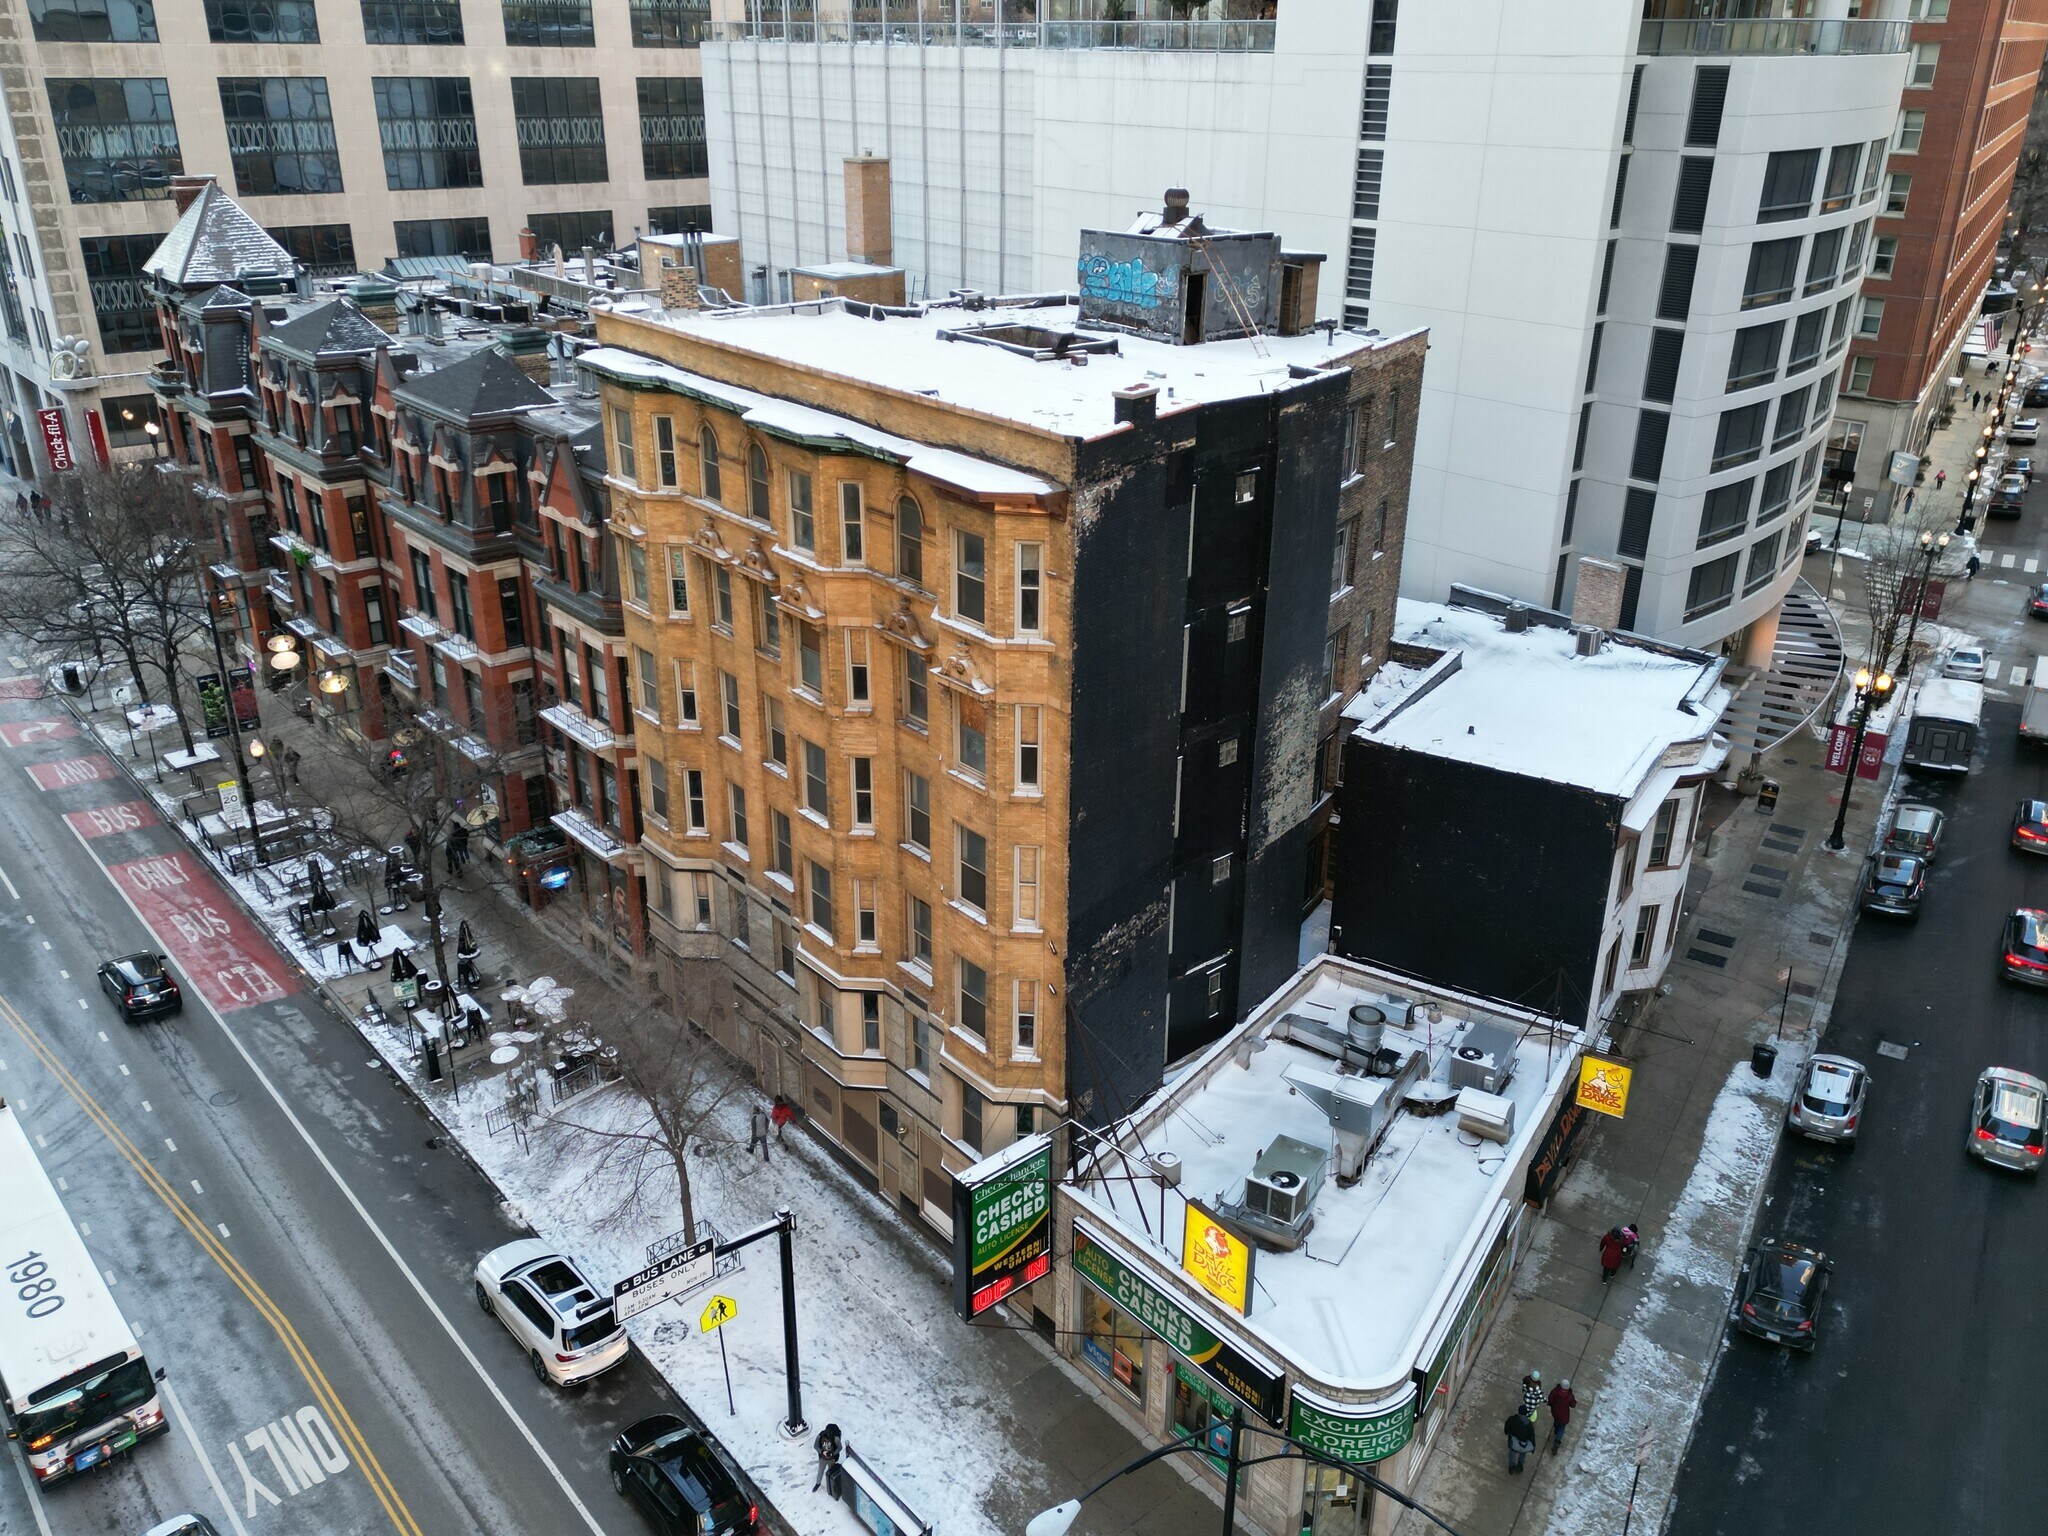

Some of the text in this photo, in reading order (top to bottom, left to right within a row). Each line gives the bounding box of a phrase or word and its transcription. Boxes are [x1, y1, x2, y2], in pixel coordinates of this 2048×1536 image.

[44, 411, 68, 469] Chick-fil-A
[1830, 729, 1846, 766] WELCOME
[54, 758, 99, 784] AND
[223, 794, 238, 805] 20
[89, 805, 141, 833] BUS
[127, 856, 190, 890] ONLY
[170, 907, 231, 943] BUS
[217, 962, 283, 1001] CTA
[1535, 1133, 1563, 1188] DEVIL
[976, 1178, 1045, 1227] CHECKS
[976, 1195, 1045, 1244] CASHED
[977, 1221, 1030, 1256] AUTO LICENSE
[993, 1240, 1040, 1271] WESTERN
[633, 1248, 696, 1287] BUS LANE
[1008, 1247, 1040, 1270] UNION
[1078, 1253, 1115, 1288] LICENSE
[1085, 1244, 1110, 1271] AUTO
[1193, 1252, 1237, 1294] DAWGS
[1194, 1239, 1236, 1279] DEVIL
[5, 1250, 65, 1319] 1980
[632, 1261, 697, 1298] BUSES ONLY
[1118, 1269, 1192, 1336] CHECKS
[1118, 1284, 1192, 1351] CASHED
[1086, 1343, 1110, 1367] vigo
[1180, 1365, 1207, 1390] CHECKS
[1180, 1371, 1207, 1396] CASHED
[1215, 1361, 1258, 1397] WESTERN
[1228, 1377, 1258, 1406] UNION
[1300, 1404, 1412, 1434] EXCHANGE
[1309, 1426, 1403, 1449] FOREIGN
[226, 1405, 350, 1519] ONLY
